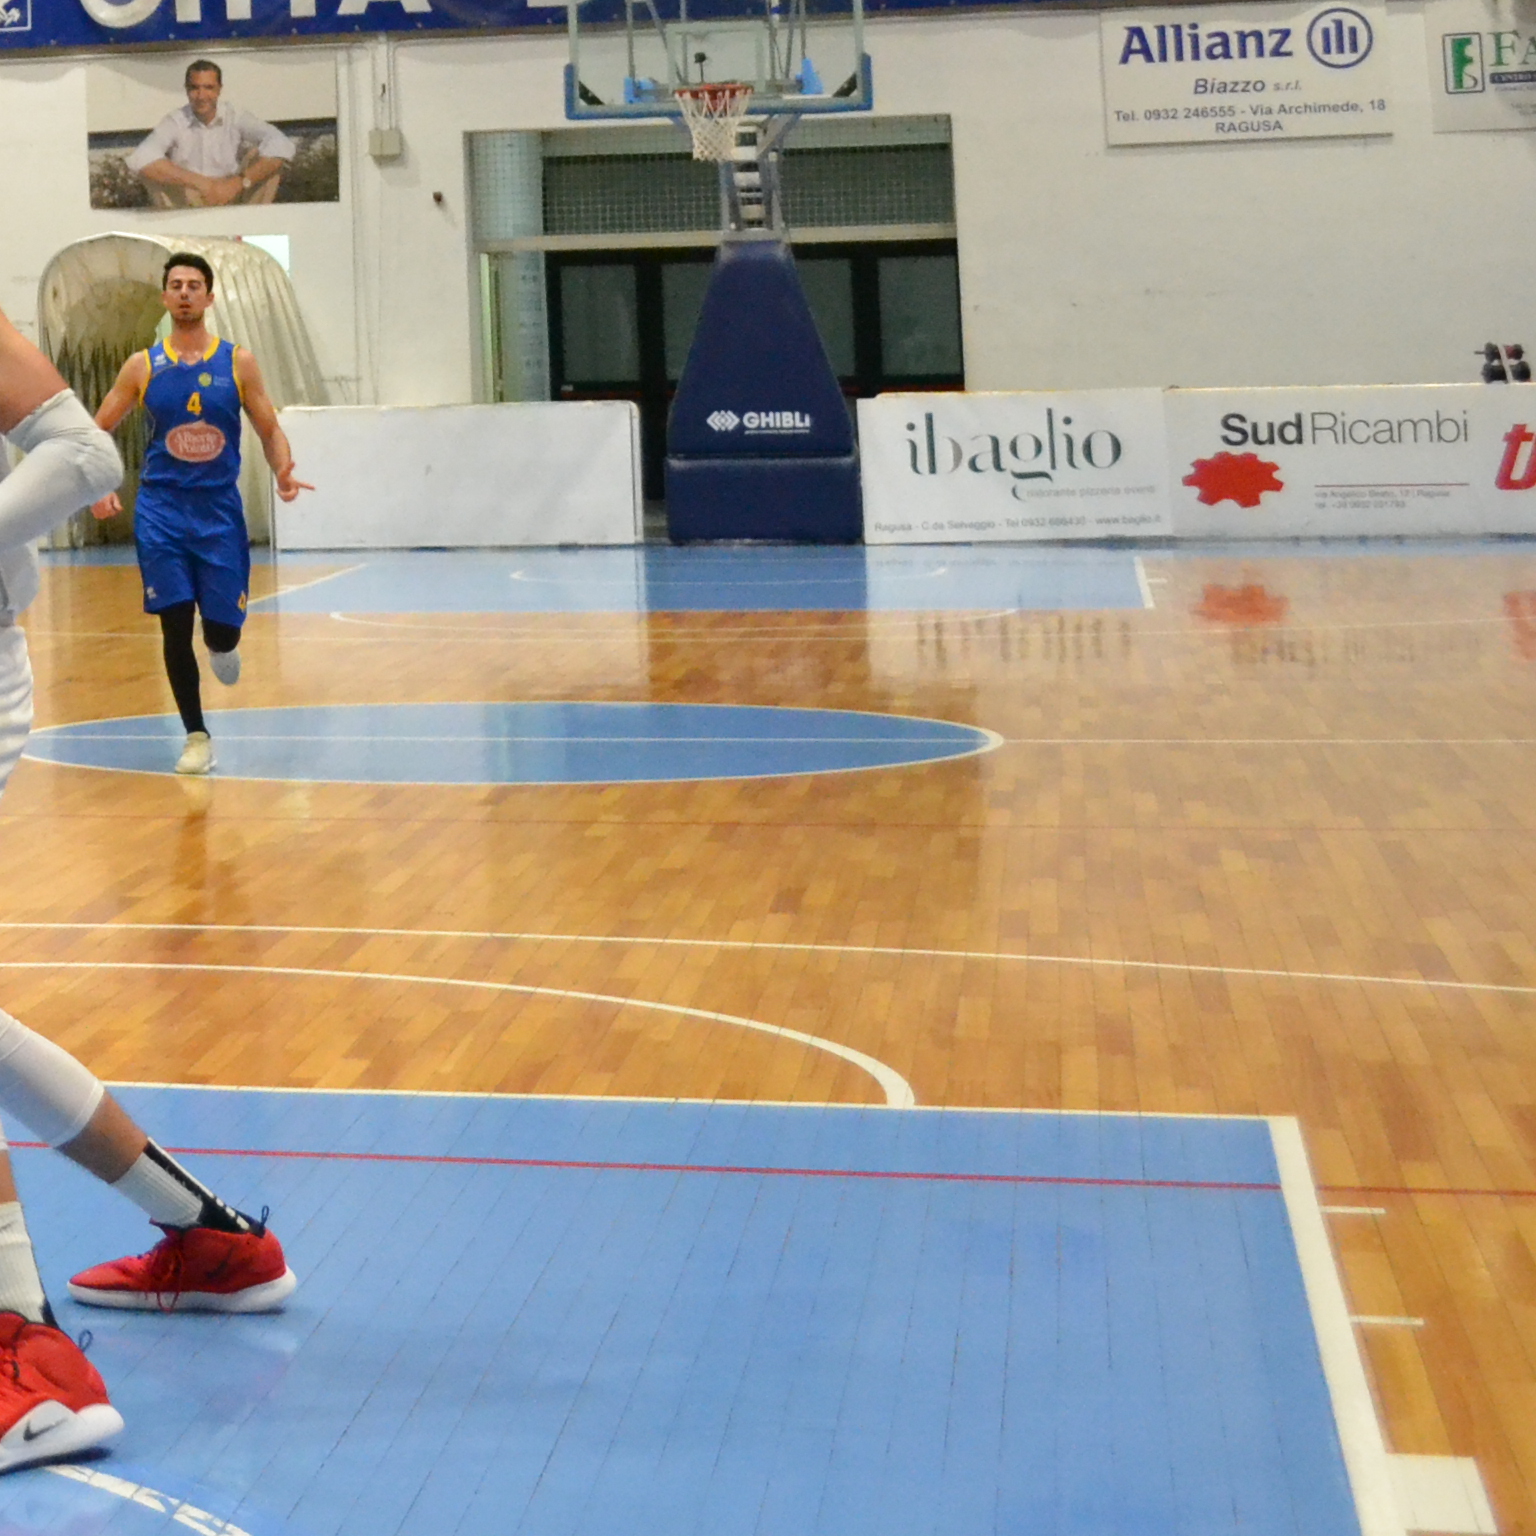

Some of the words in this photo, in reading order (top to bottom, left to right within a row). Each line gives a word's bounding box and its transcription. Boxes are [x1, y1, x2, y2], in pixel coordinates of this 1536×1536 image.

[1118, 22, 1294, 66] Allianz
[1192, 77, 1267, 96] Biazzo
[1114, 110, 1139, 123] Tel.
[1143, 108, 1178, 121] 0932
[1183, 105, 1236, 120] 246555
[1249, 103, 1274, 117] Via
[1277, 99, 1364, 117] Archimede,
[1368, 98, 1387, 112] 18
[1214, 120, 1284, 135] RAGUSA
[186, 391, 203, 416] 4
[905, 407, 1123, 502] ibaglio
